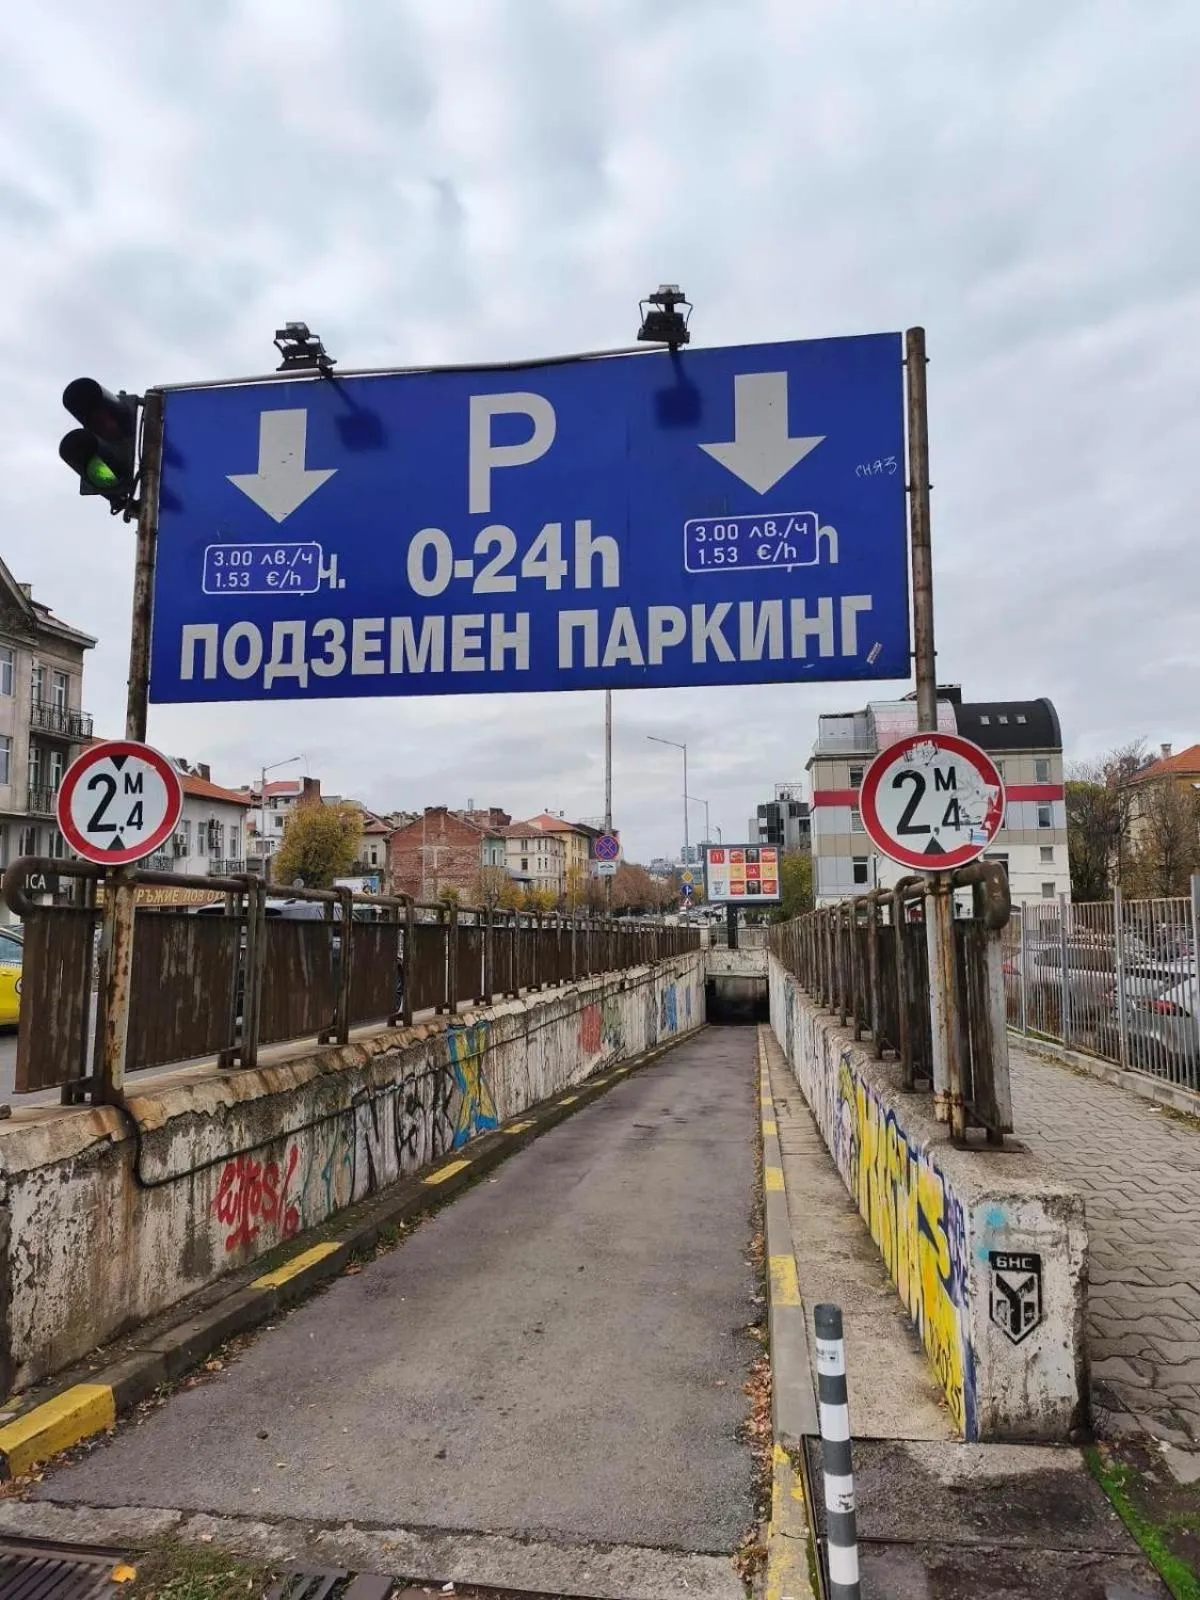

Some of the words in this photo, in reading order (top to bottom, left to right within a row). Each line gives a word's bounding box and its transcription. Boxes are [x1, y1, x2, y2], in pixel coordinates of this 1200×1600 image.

[468, 391, 557, 514] P
[695, 524, 739, 542] 3.00
[749, 518, 808, 539] лв./ч
[213, 551, 253, 566] 3.00
[260, 547, 313, 567] лв./ч
[406, 519, 621, 597] 0-24h
[698, 547, 738, 564] 1.53
[756, 541, 797, 562] €/h
[215, 571, 250, 588] 1.53
[265, 569, 302, 588] €/h
[179, 611, 531, 689] ПОДЗЕМЕН
[558, 594, 873, 669] ПАРКИНГ
[135, 887, 179, 904] РЪЖИЕ
